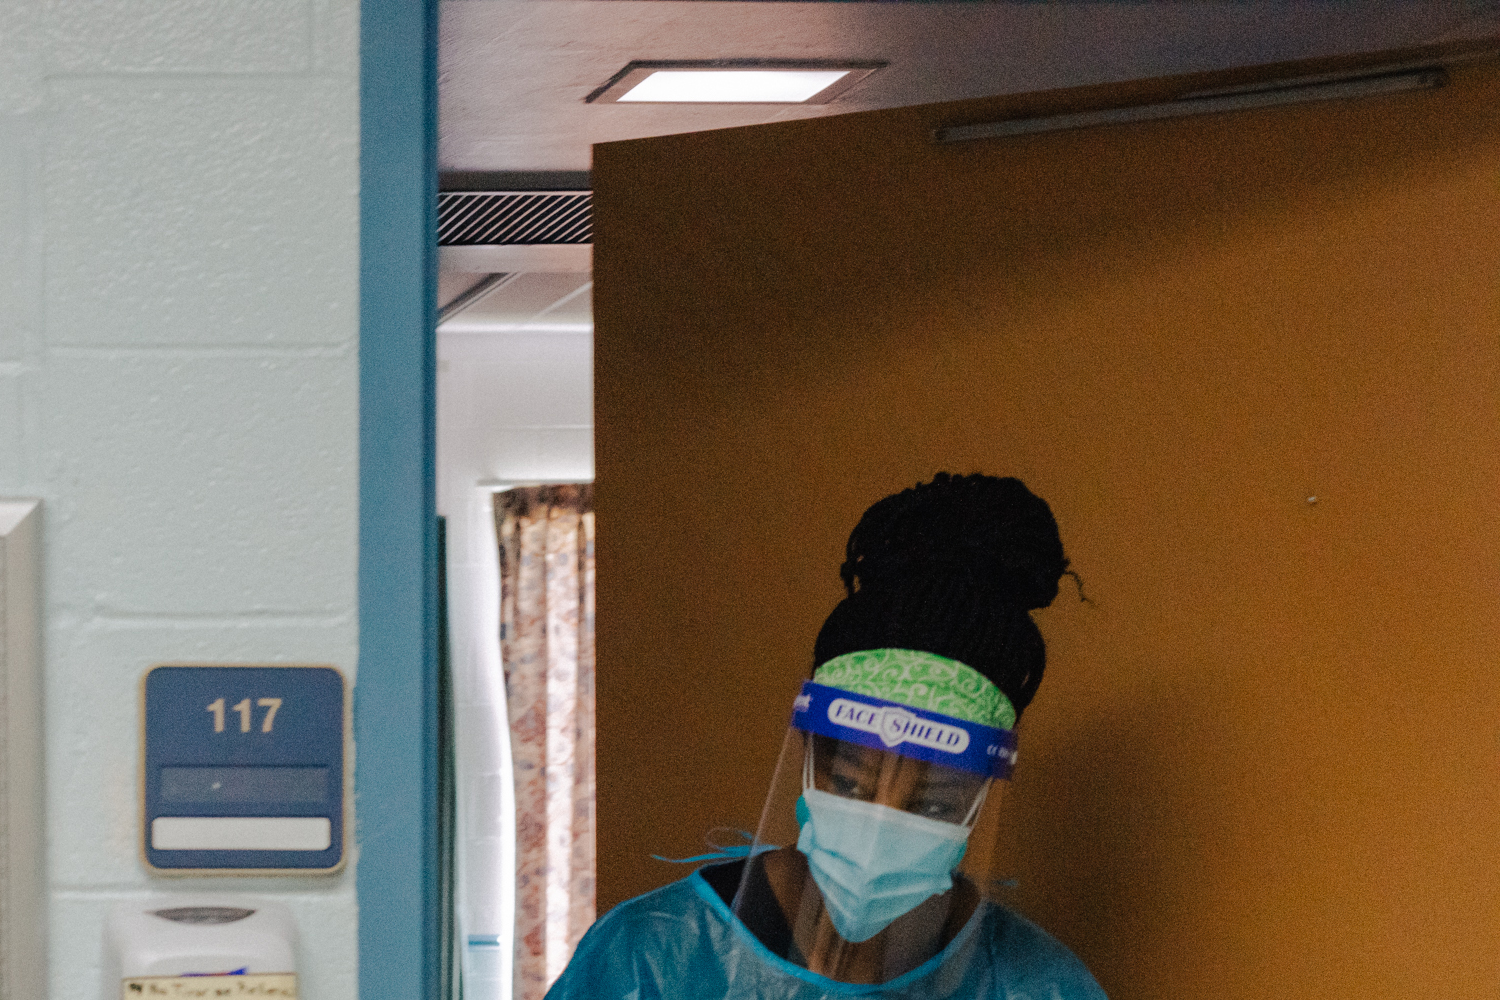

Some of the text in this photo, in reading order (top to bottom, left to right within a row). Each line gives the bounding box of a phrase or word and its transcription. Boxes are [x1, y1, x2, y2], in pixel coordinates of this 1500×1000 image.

[206, 697, 283, 734] 117
[834, 703, 961, 747] FACE SHIELD
